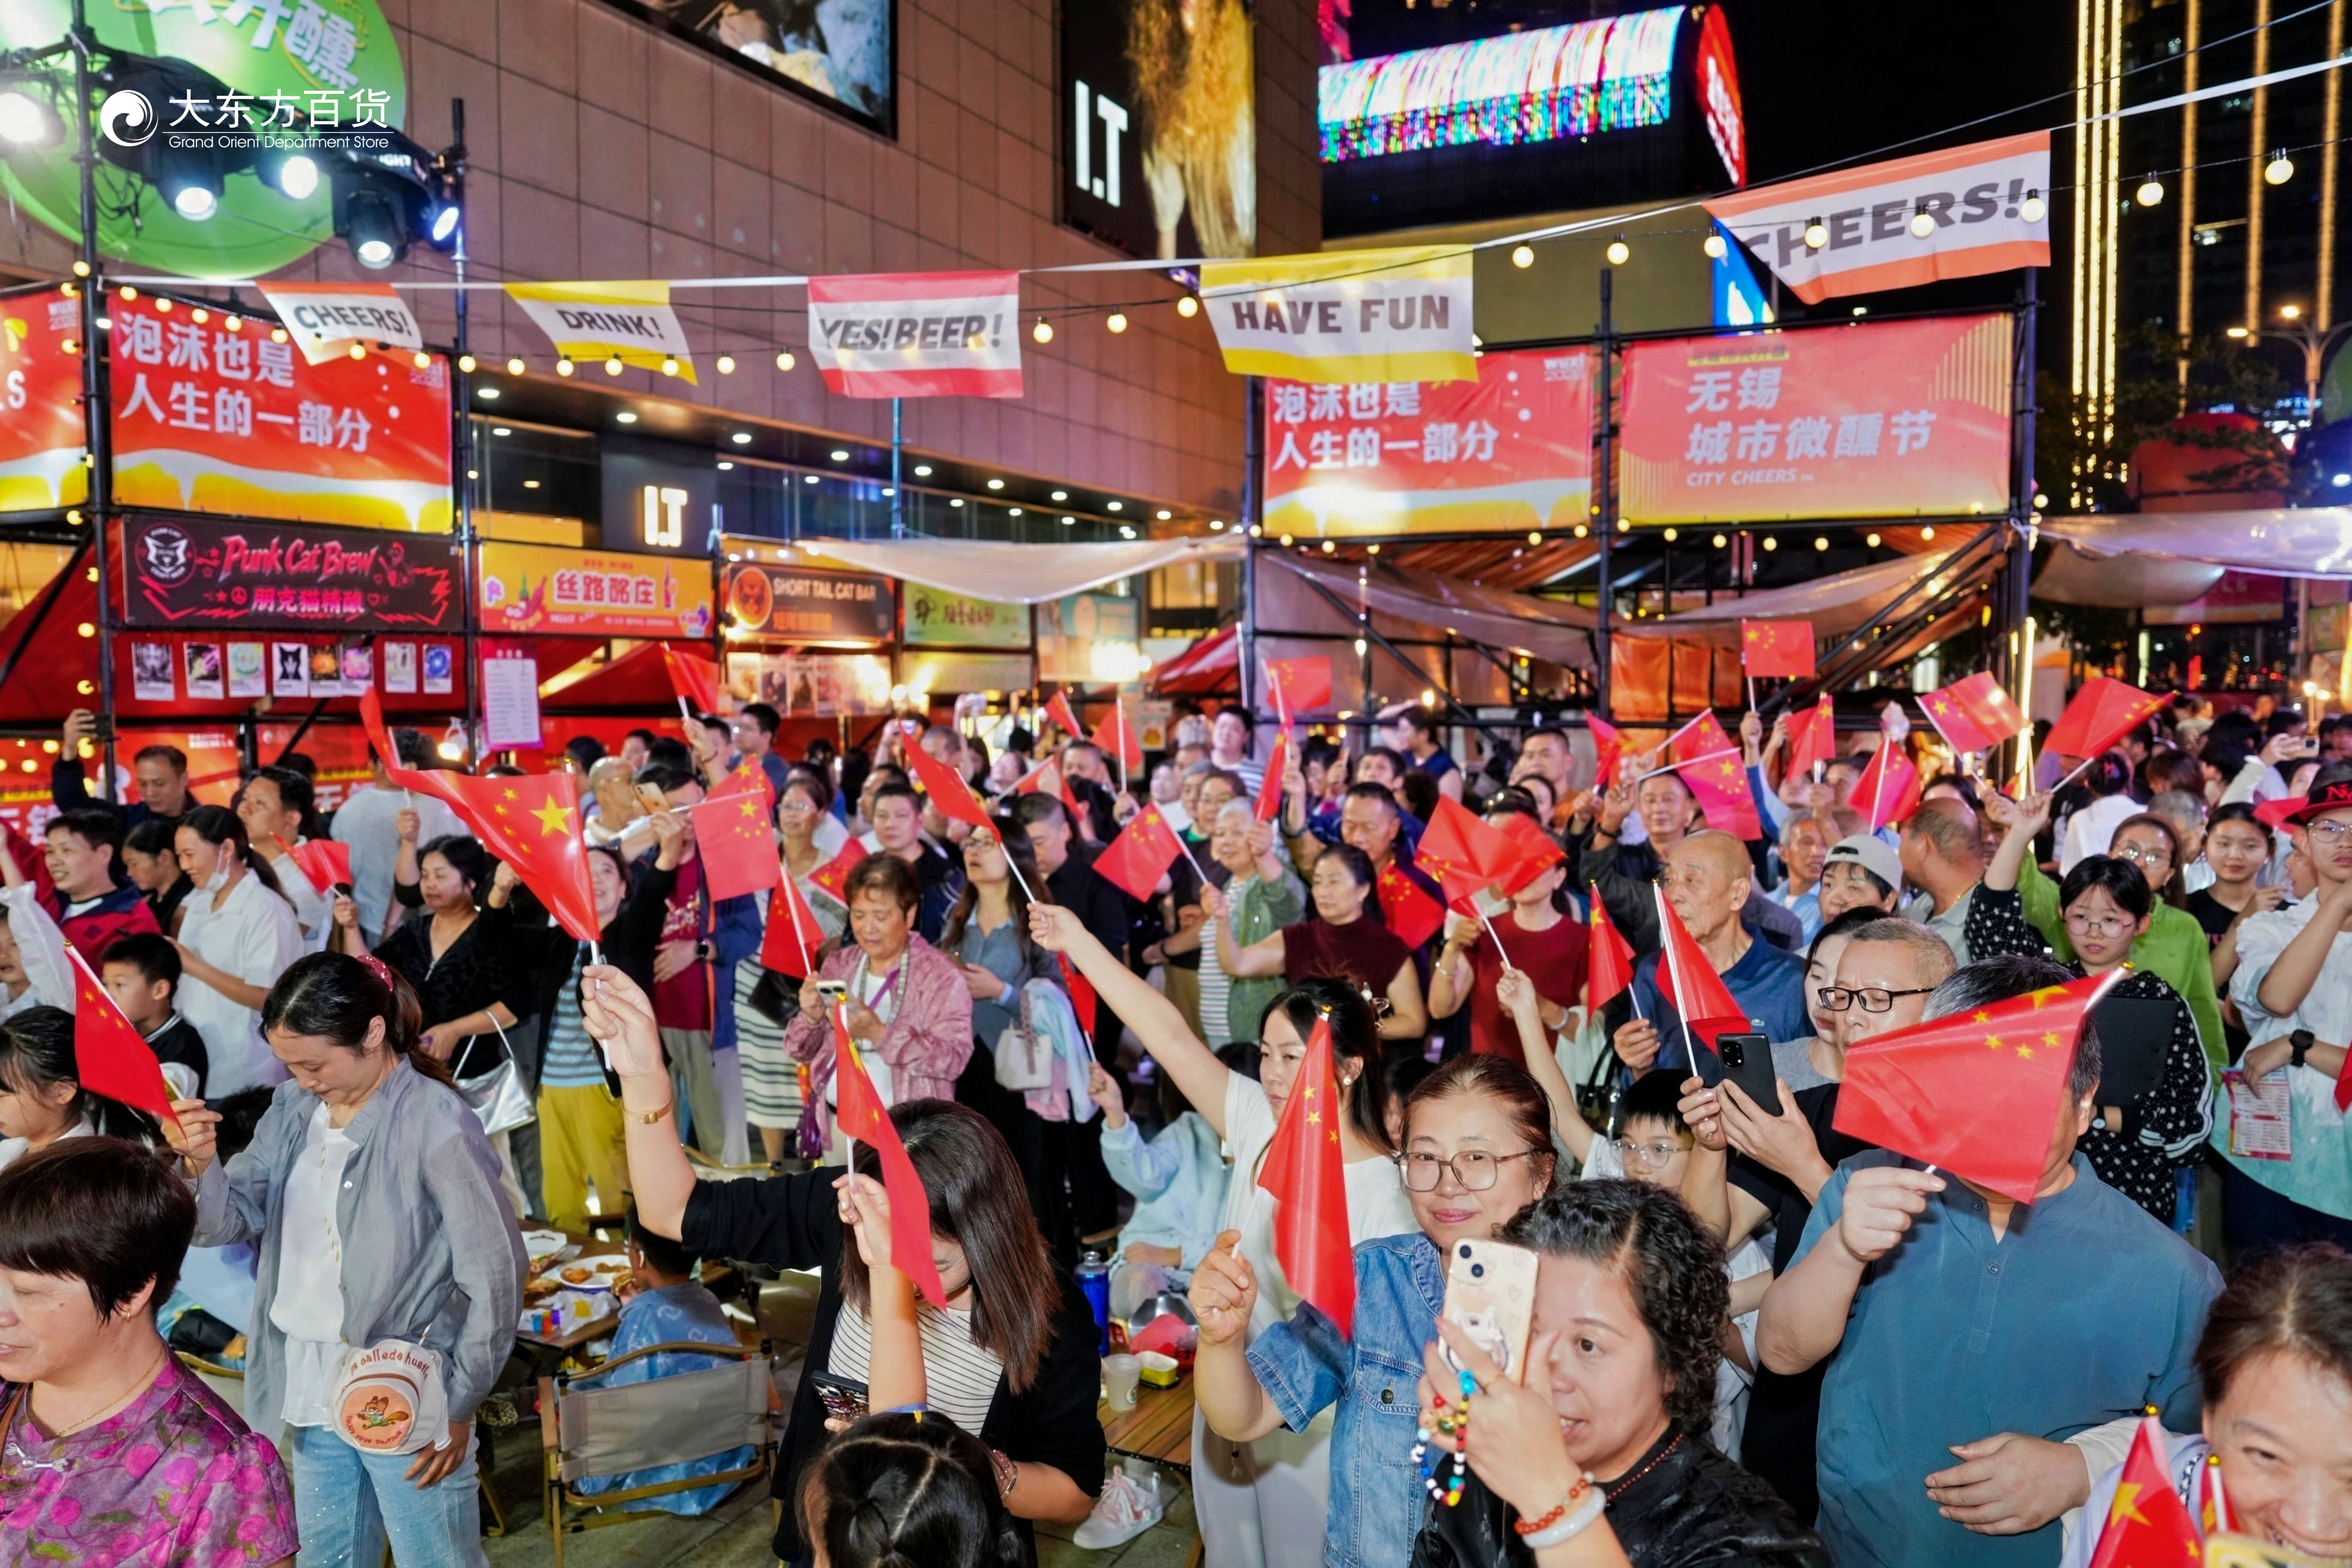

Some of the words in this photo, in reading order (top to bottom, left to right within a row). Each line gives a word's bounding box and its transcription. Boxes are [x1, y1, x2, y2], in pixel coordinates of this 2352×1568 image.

[1074, 79, 1128, 208] I.T
[293, 305, 412, 337] CHEERS!
[556, 309, 665, 340] DRINK!
[1232, 300, 1343, 335] HAVE
[1359, 295, 1450, 333] FUN
[119, 309, 295, 388] 泡沫也是
[119, 372, 373, 453] 人生的一部分
[1272, 380, 1422, 424] 泡沫也是
[1685, 366, 1782, 414] 无锡
[1271, 420, 1500, 472] 人生的一部分
[1685, 409, 1937, 465] 城市微醺节
[1686, 470, 1725, 487] CITY
[1731, 468, 1797, 485] CHEERS
[218, 534, 282, 583] Punk
[284, 538, 322, 574] Cat
[317, 540, 379, 583] Brew
[772, 577, 811, 597] SHORT
[812, 579, 834, 599] TAIL
[834, 581, 855, 600] CAT
[855, 584, 876, 601] BAR
